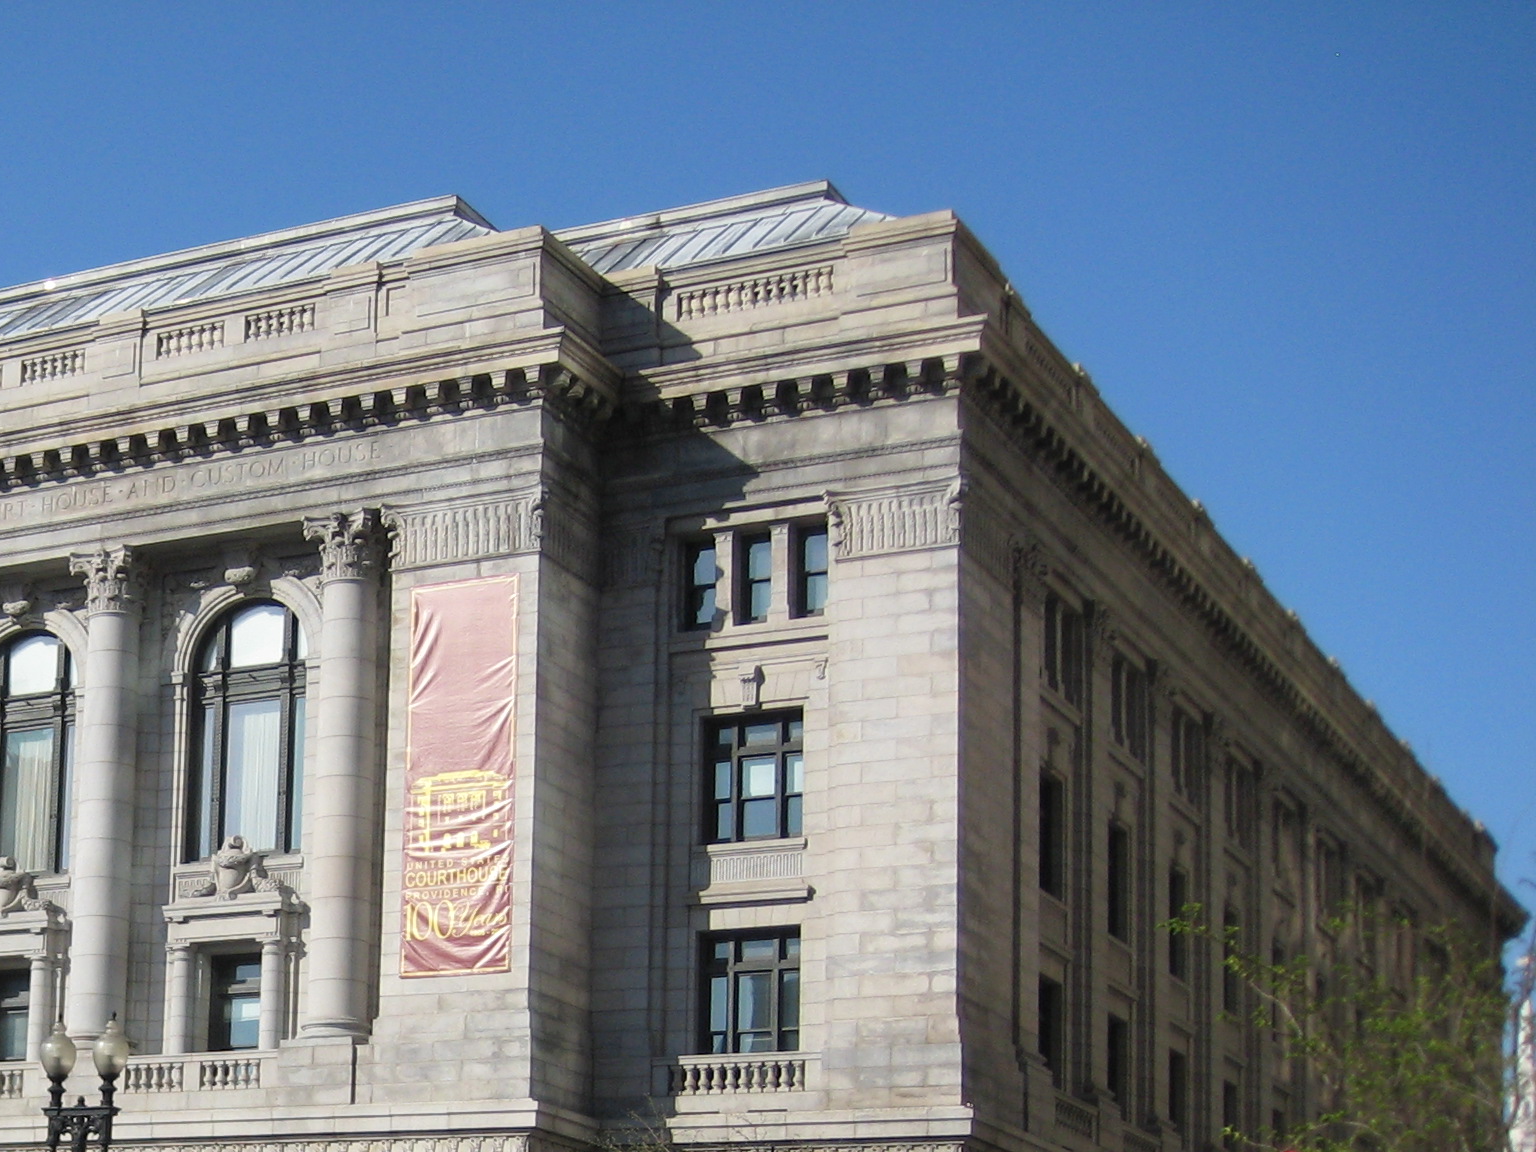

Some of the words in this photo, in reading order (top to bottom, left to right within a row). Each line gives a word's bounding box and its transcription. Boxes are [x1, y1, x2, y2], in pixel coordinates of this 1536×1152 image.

[41, 484, 114, 514] HOUSE
[126, 475, 176, 501] AND
[190, 458, 285, 489] CUSTOM
[302, 440, 383, 471] HOUSE
[405, 865, 508, 888] COURTHOUSE
[406, 859, 453, 870] UNITED
[404, 900, 454, 941] 100
[452, 902, 508, 938] Years
